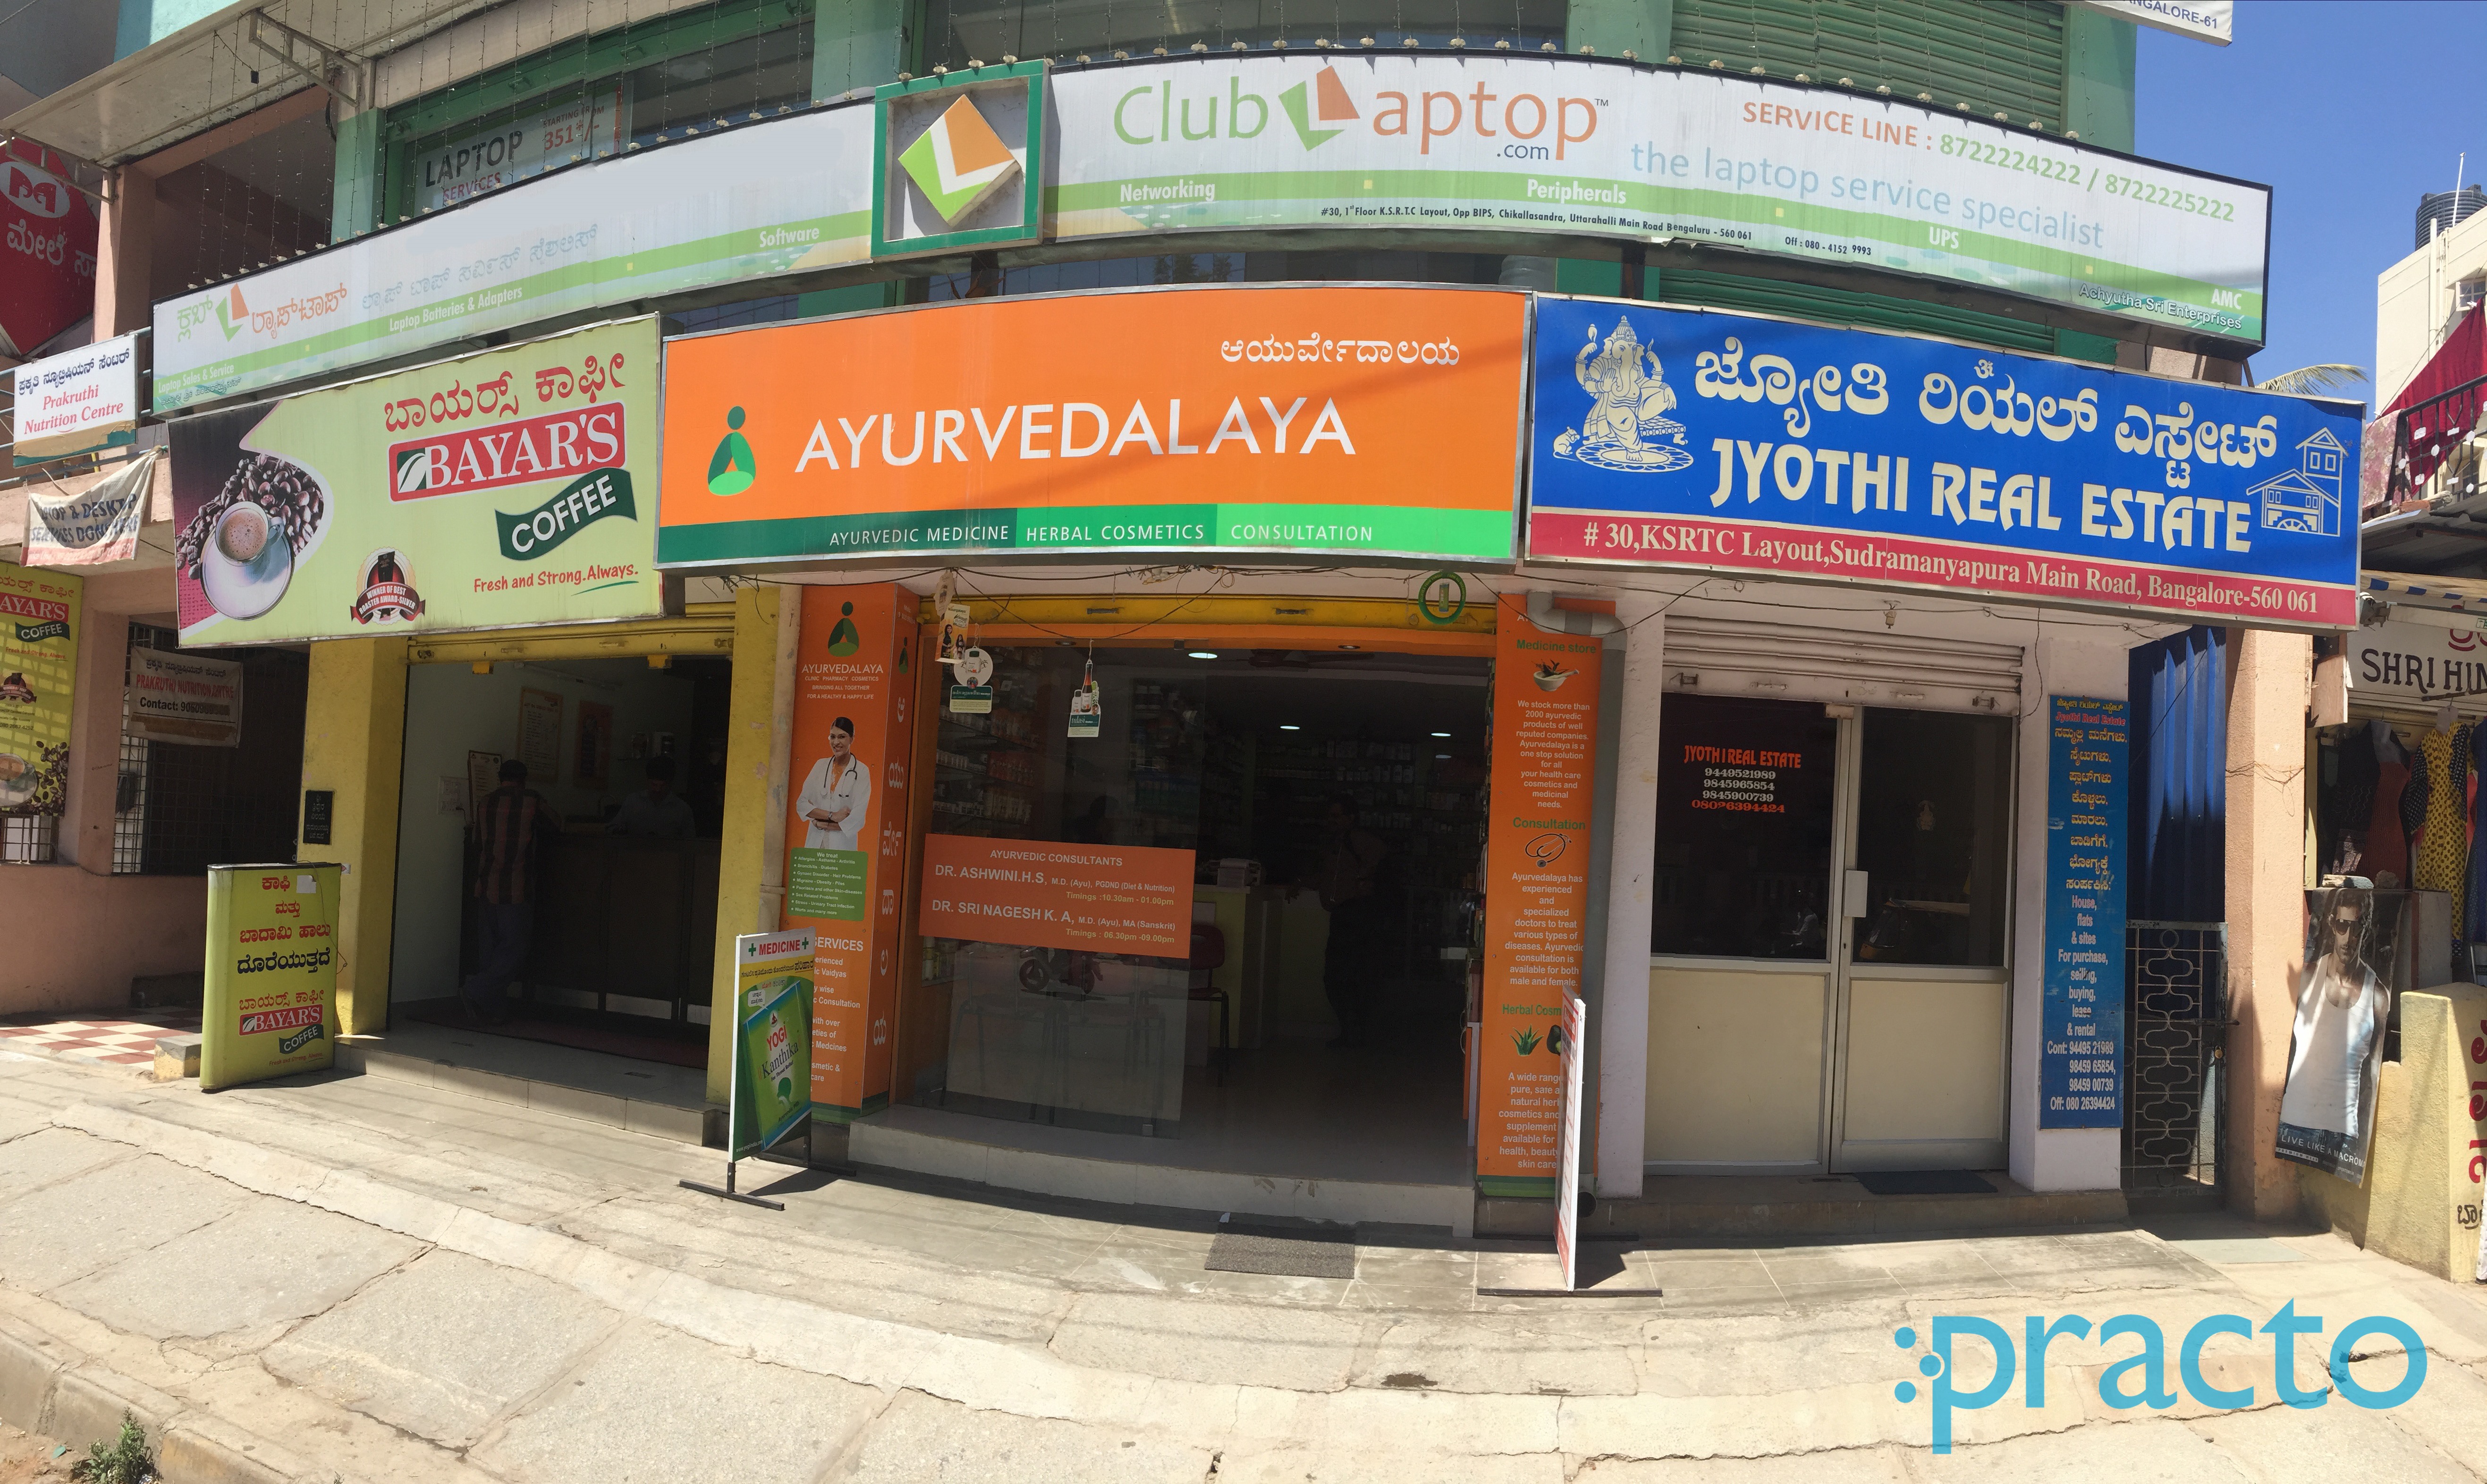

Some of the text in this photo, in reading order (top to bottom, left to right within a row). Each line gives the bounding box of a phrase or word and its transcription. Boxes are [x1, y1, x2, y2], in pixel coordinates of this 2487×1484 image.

[543, 108, 579, 128] STARTING
[1113, 76, 1269, 145] Club
[425, 130, 523, 187] LAPTOP
[1496, 143, 1549, 160] .com
[1743, 101, 2234, 222] SERVICE LINE 8722224222 8722225222
[443, 172, 501, 202] SERVICES
[1120, 179, 1216, 203] Networking
[1526, 179, 1626, 204] Peripherals
[1632, 141, 2104, 249] the laptop service specialist
[1321, 206, 1752, 240] #30, Floor K.S.R.T.C Layout, Opp BIPS, Chikallasandra, Uttarahalli Main Road Bengaluru 560 061
[760, 228, 820, 247] Software
[1785, 236, 1871, 255] Off 080 4152 9993
[1929, 227, 1959, 249] UPS
[389, 287, 522, 332] Laptop Batteries & Adapters
[2079, 283, 2242, 330] Achyutha Sri Enterprises
[2211, 288, 2242, 311] AMC
[158, 378, 181, 395] Laptop
[183, 369, 200, 385] Sales
[210, 363, 234, 379] Service
[42, 384, 99, 411] Prakruthi
[24, 403, 124, 435] Nutrition Centre
[795, 396, 1355, 472] AYURVEDALAYA
[425, 411, 619, 489] BAYAR'S
[1710, 438, 2251, 554] JYOTHI REAL ESTATE
[512, 474, 617, 553] COFFEE
[829, 523, 1372, 546] AYURVEDIC MEDICINE HERBAL COSMETICS CONSULTATION
[1605, 523, 1734, 556] 30,KSRTC
[2027, 561, 2078, 590] Main
[2086, 569, 2141, 601] Road,
[2149, 575, 2282, 613] Bangalore-560
[2288, 590, 2318, 614] 061
[366, 586, 386, 599] WINNER
[394, 586, 406, 596] BEST
[474, 575, 508, 593] Fresh
[511, 574, 534, 588] and
[0, 595, 65, 620] AYAR'S
[359, 595, 416, 615] ROASTER AWARD-SILVER
[21, 623, 62, 639] COFFEE
[1517, 639, 1596, 654] Medicine store
[801, 664, 883, 674] AYURVEDALAYA
[2361, 649, 2436, 694] SHRI
[136, 674, 211, 697] PRAKRUTHI NUTRITION
[140, 697, 178, 711] Contact:
[1523, 721, 1556, 729] products
[1546, 711, 1582, 720] ayurvedic
[2055, 711, 2125, 725] Jyothi Real Estate
[1684, 745, 1801, 768] JYOTHI REAL ESTATE
[1705, 767, 1776, 779] 9449521989
[1702, 790, 1773, 801] 9845900739
[1704, 779, 1775, 791] 9845965854
[1513, 817, 1585, 830] Consultation
[990, 850, 1122, 866] AYURVEDIC CONSULTANTS
[1144, 883, 1175, 893] Nutrition)
[1522, 885, 1572, 894] experienced
[1066, 892, 1174, 906] Timings 01.00pm
[983, 904, 1175, 931] NAGESH (Sanskrit)
[759, 940, 800, 955] MEDICINE
[2072, 950, 2108, 965] purchase,
[822, 969, 846, 978] Vaidyas
[818, 996, 860, 1008] Consultation
[254, 1006, 321, 1031] BAYAR'S
[283, 1027, 318, 1052] COFFEE
[767, 1025, 787, 1051] YOGI
[2074, 1023, 2095, 1036] rental
[816, 1043, 847, 1052] Medcines
[2047, 1041, 2067, 1054] Cont:
[761, 1042, 798, 1079] Kanthika
[2282, 1135, 2304, 1147] LIVE
[2307, 1142, 2325, 1153] LIKE
